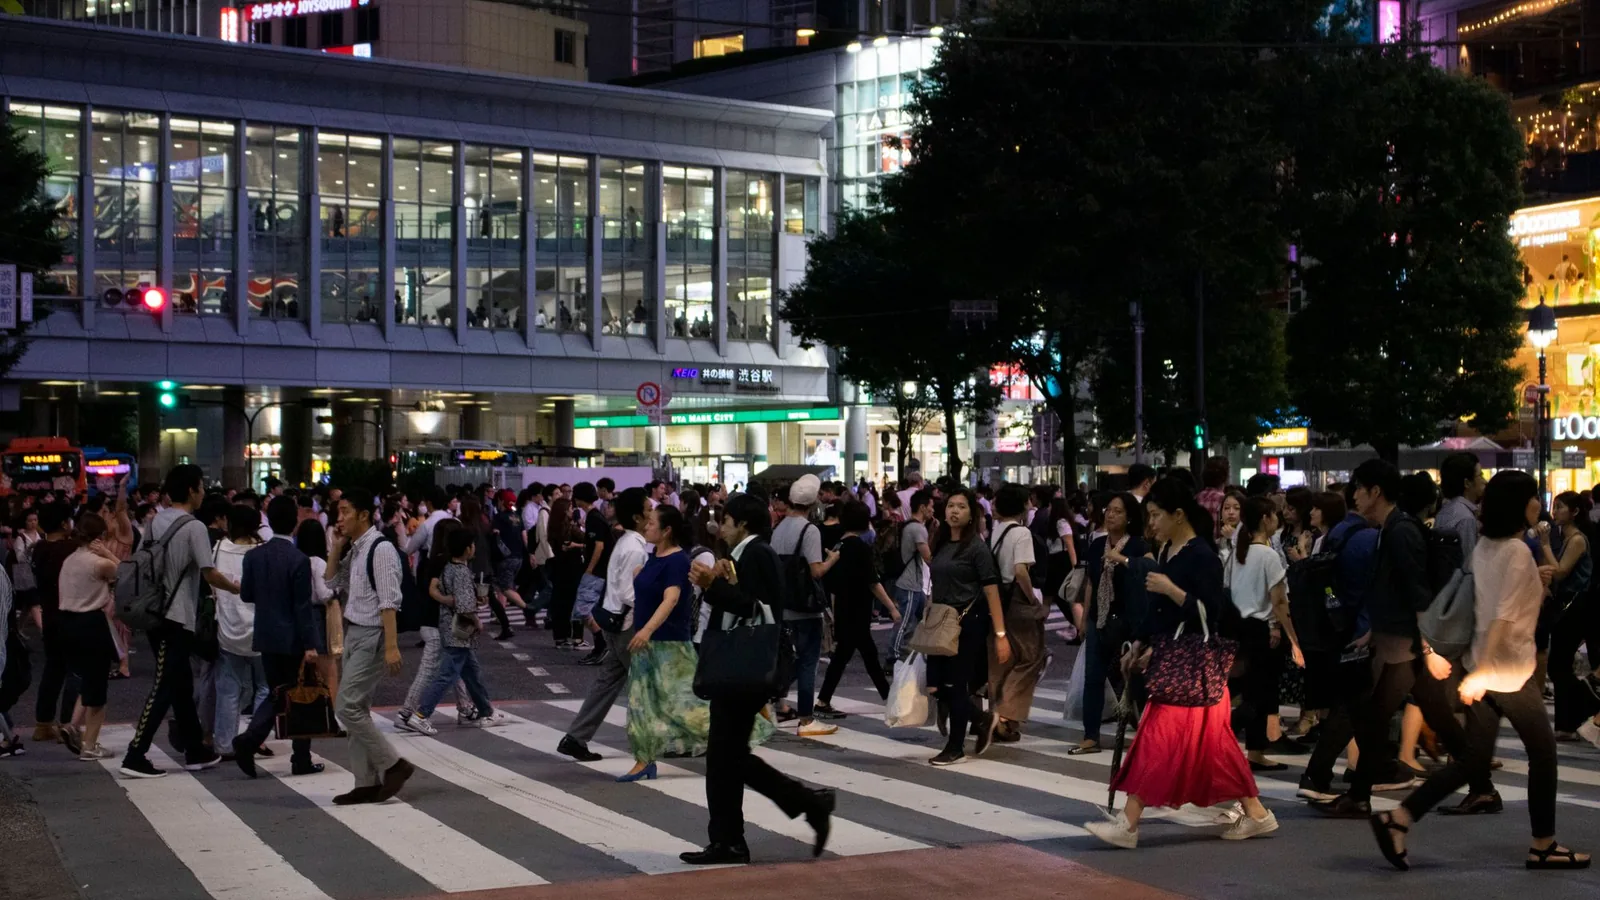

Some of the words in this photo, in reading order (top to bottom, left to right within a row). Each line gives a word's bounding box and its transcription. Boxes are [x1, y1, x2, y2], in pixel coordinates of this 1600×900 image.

[251, 1, 296, 20] カラオケ
[297, 0, 352, 14] JOYSOUND
[671, 367, 699, 379] KEIO
[702, 368, 734, 380] 井の頭線
[738, 368, 773, 383] 渋谷駅
[688, 413, 712, 423] MARK
[713, 413, 734, 422] CITY
